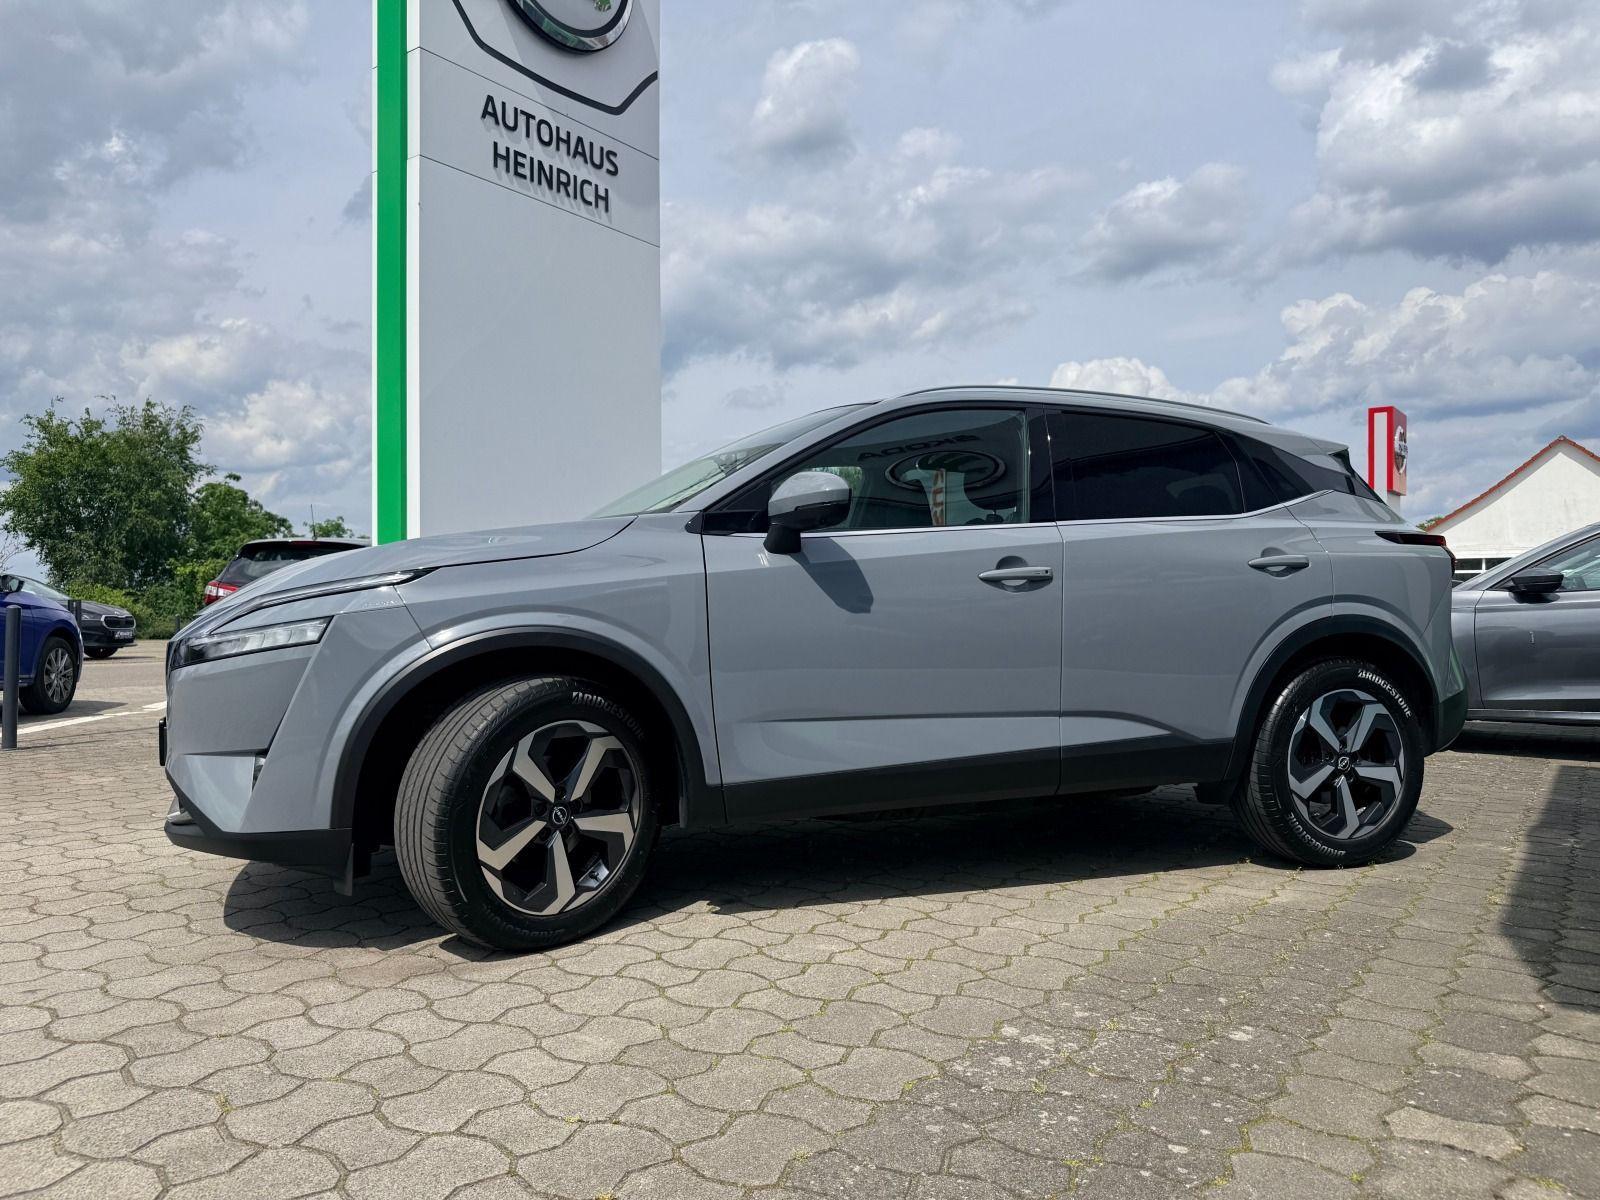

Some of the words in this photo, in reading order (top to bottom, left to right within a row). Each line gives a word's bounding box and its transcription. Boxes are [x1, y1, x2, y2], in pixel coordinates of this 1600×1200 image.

[481, 94, 619, 176] AUTOHAUS
[493, 141, 609, 213] HEINRICH
[1358, 669, 1411, 718] BRIDGESTONE
